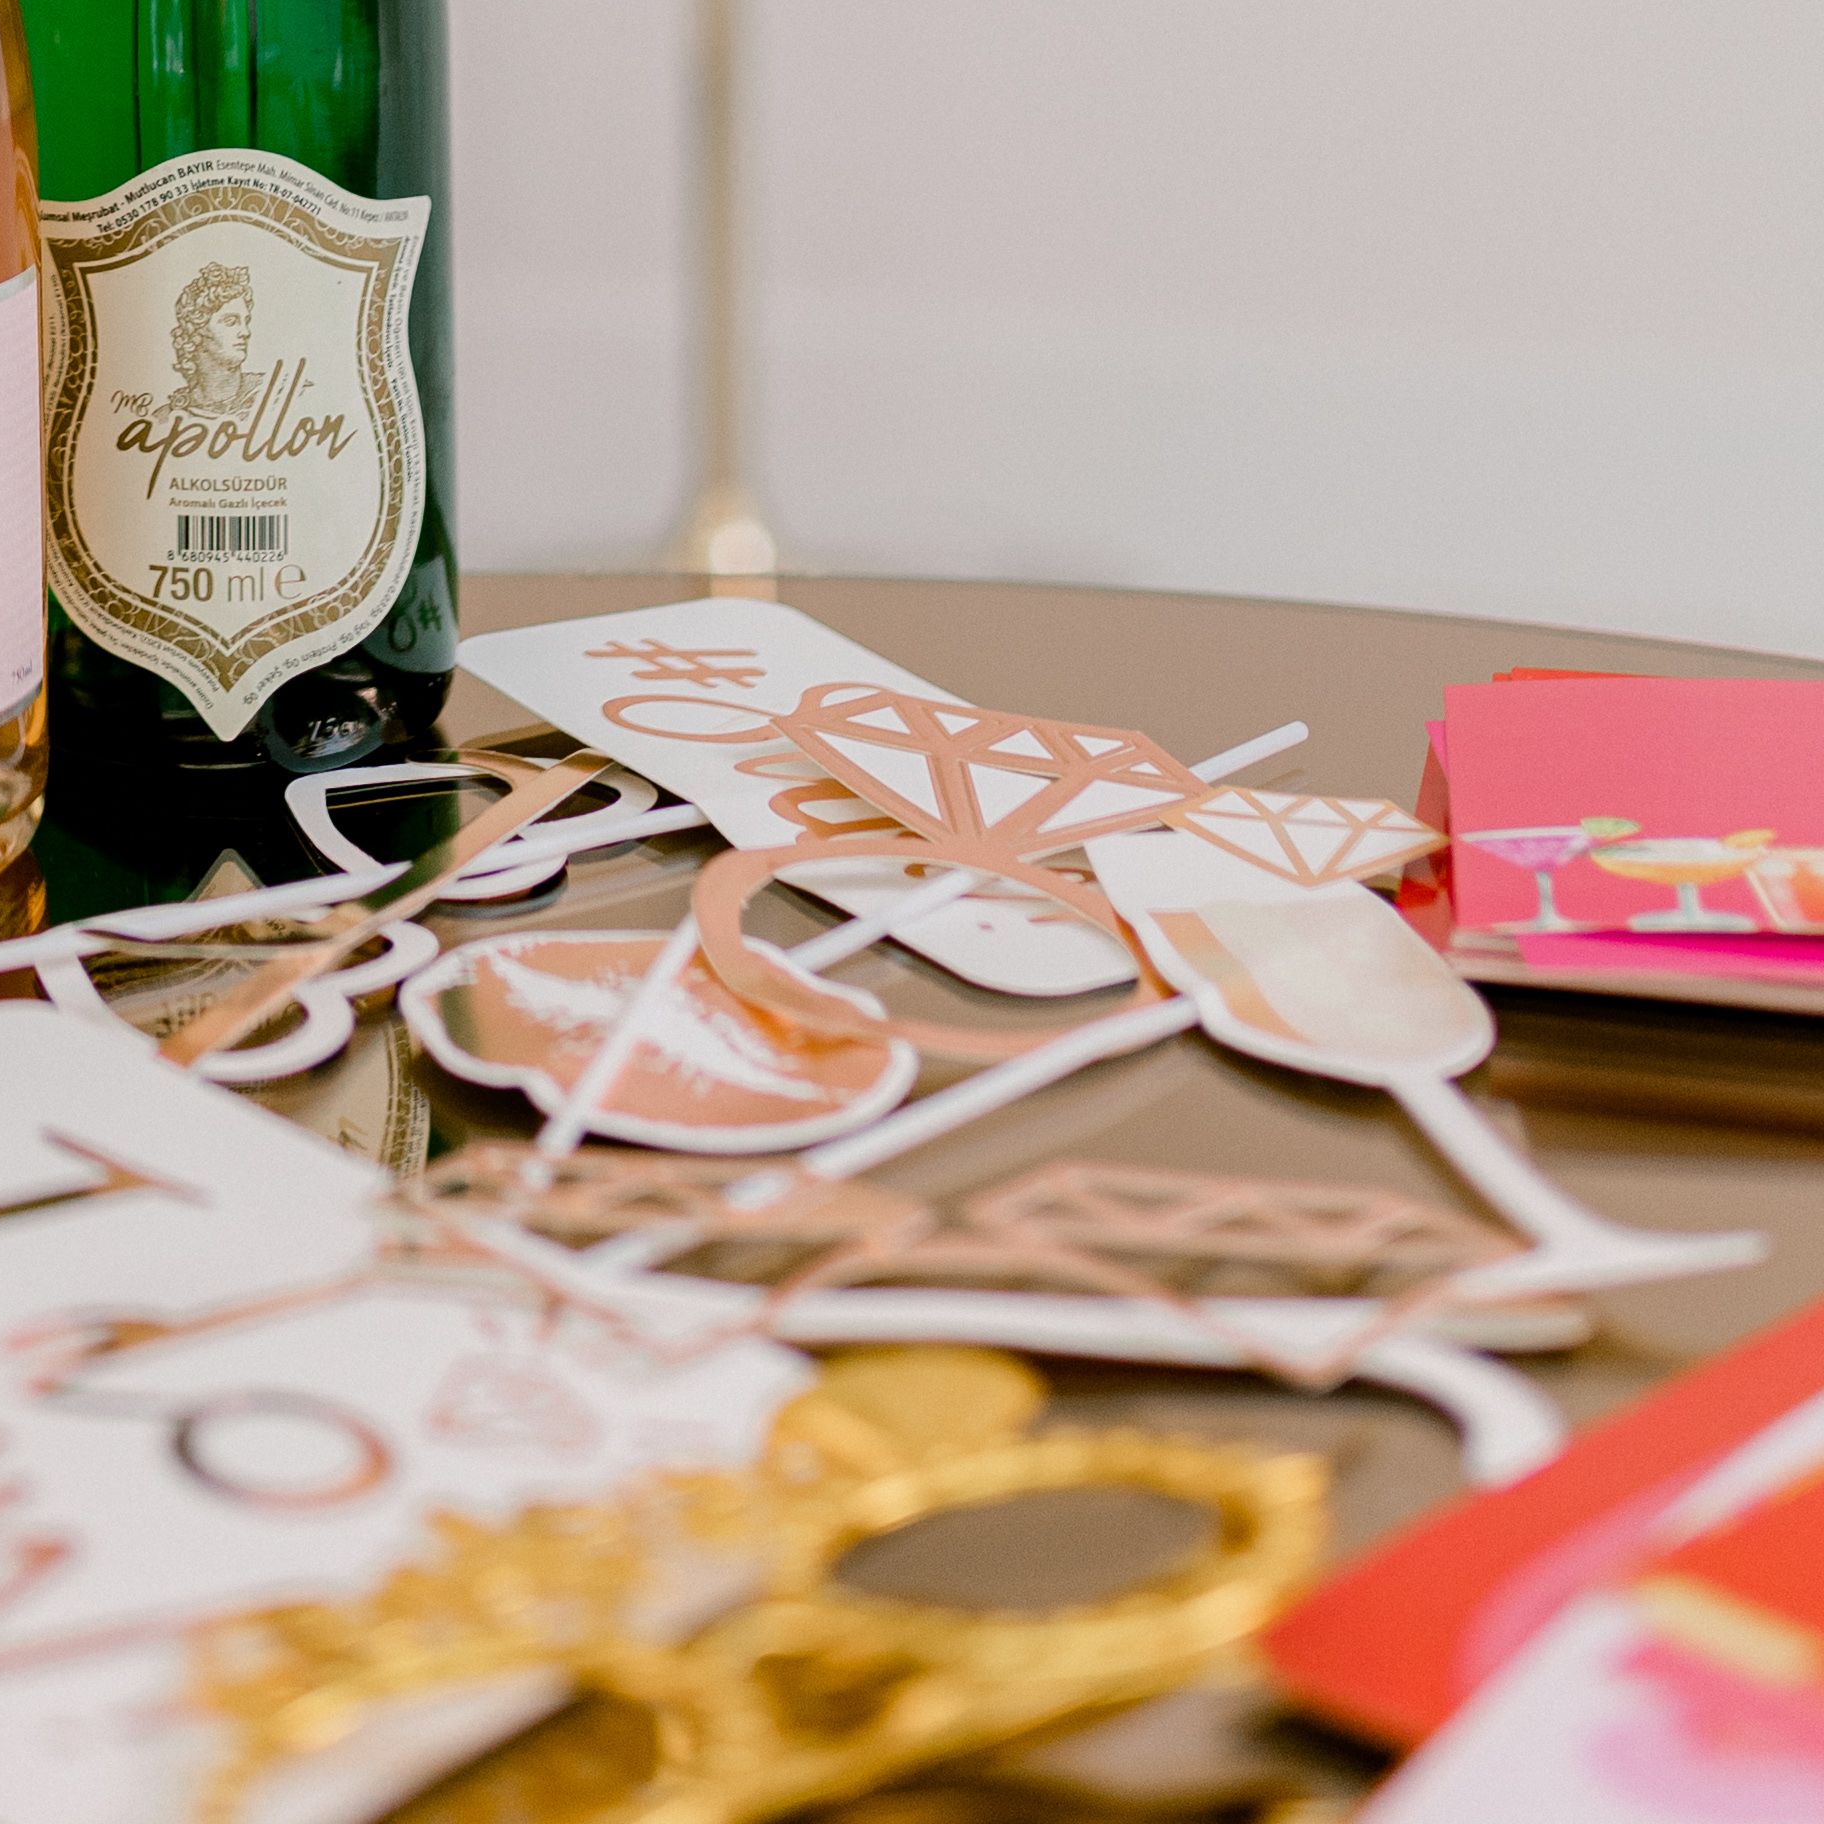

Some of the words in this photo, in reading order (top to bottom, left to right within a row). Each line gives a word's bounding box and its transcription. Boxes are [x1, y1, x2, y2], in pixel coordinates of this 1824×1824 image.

[72, 202, 120, 224] Meşrubat
[125, 173, 176, 205] Mutlucan
[177, 160, 213, 178] BAYIR
[96, 219, 114, 234] Tel:
[115, 209, 140, 227] 0530
[139, 197, 159, 212] 178
[158, 189, 174, 202] 90
[174, 182, 190, 195] 33
[116, 357, 358, 500] apollon
[168, 475, 288, 493] ALKOLSÜZDÜR
[168, 497, 216, 508] Aromalı
[218, 497, 248, 509] Gazlı
[251, 496, 288, 510] İçecek
[167, 550, 175, 561] 8
[181, 551, 230, 562] 680945
[236, 551, 285, 562] 440226
[148, 564, 214, 602] 750
[226, 566, 264, 602] ml
